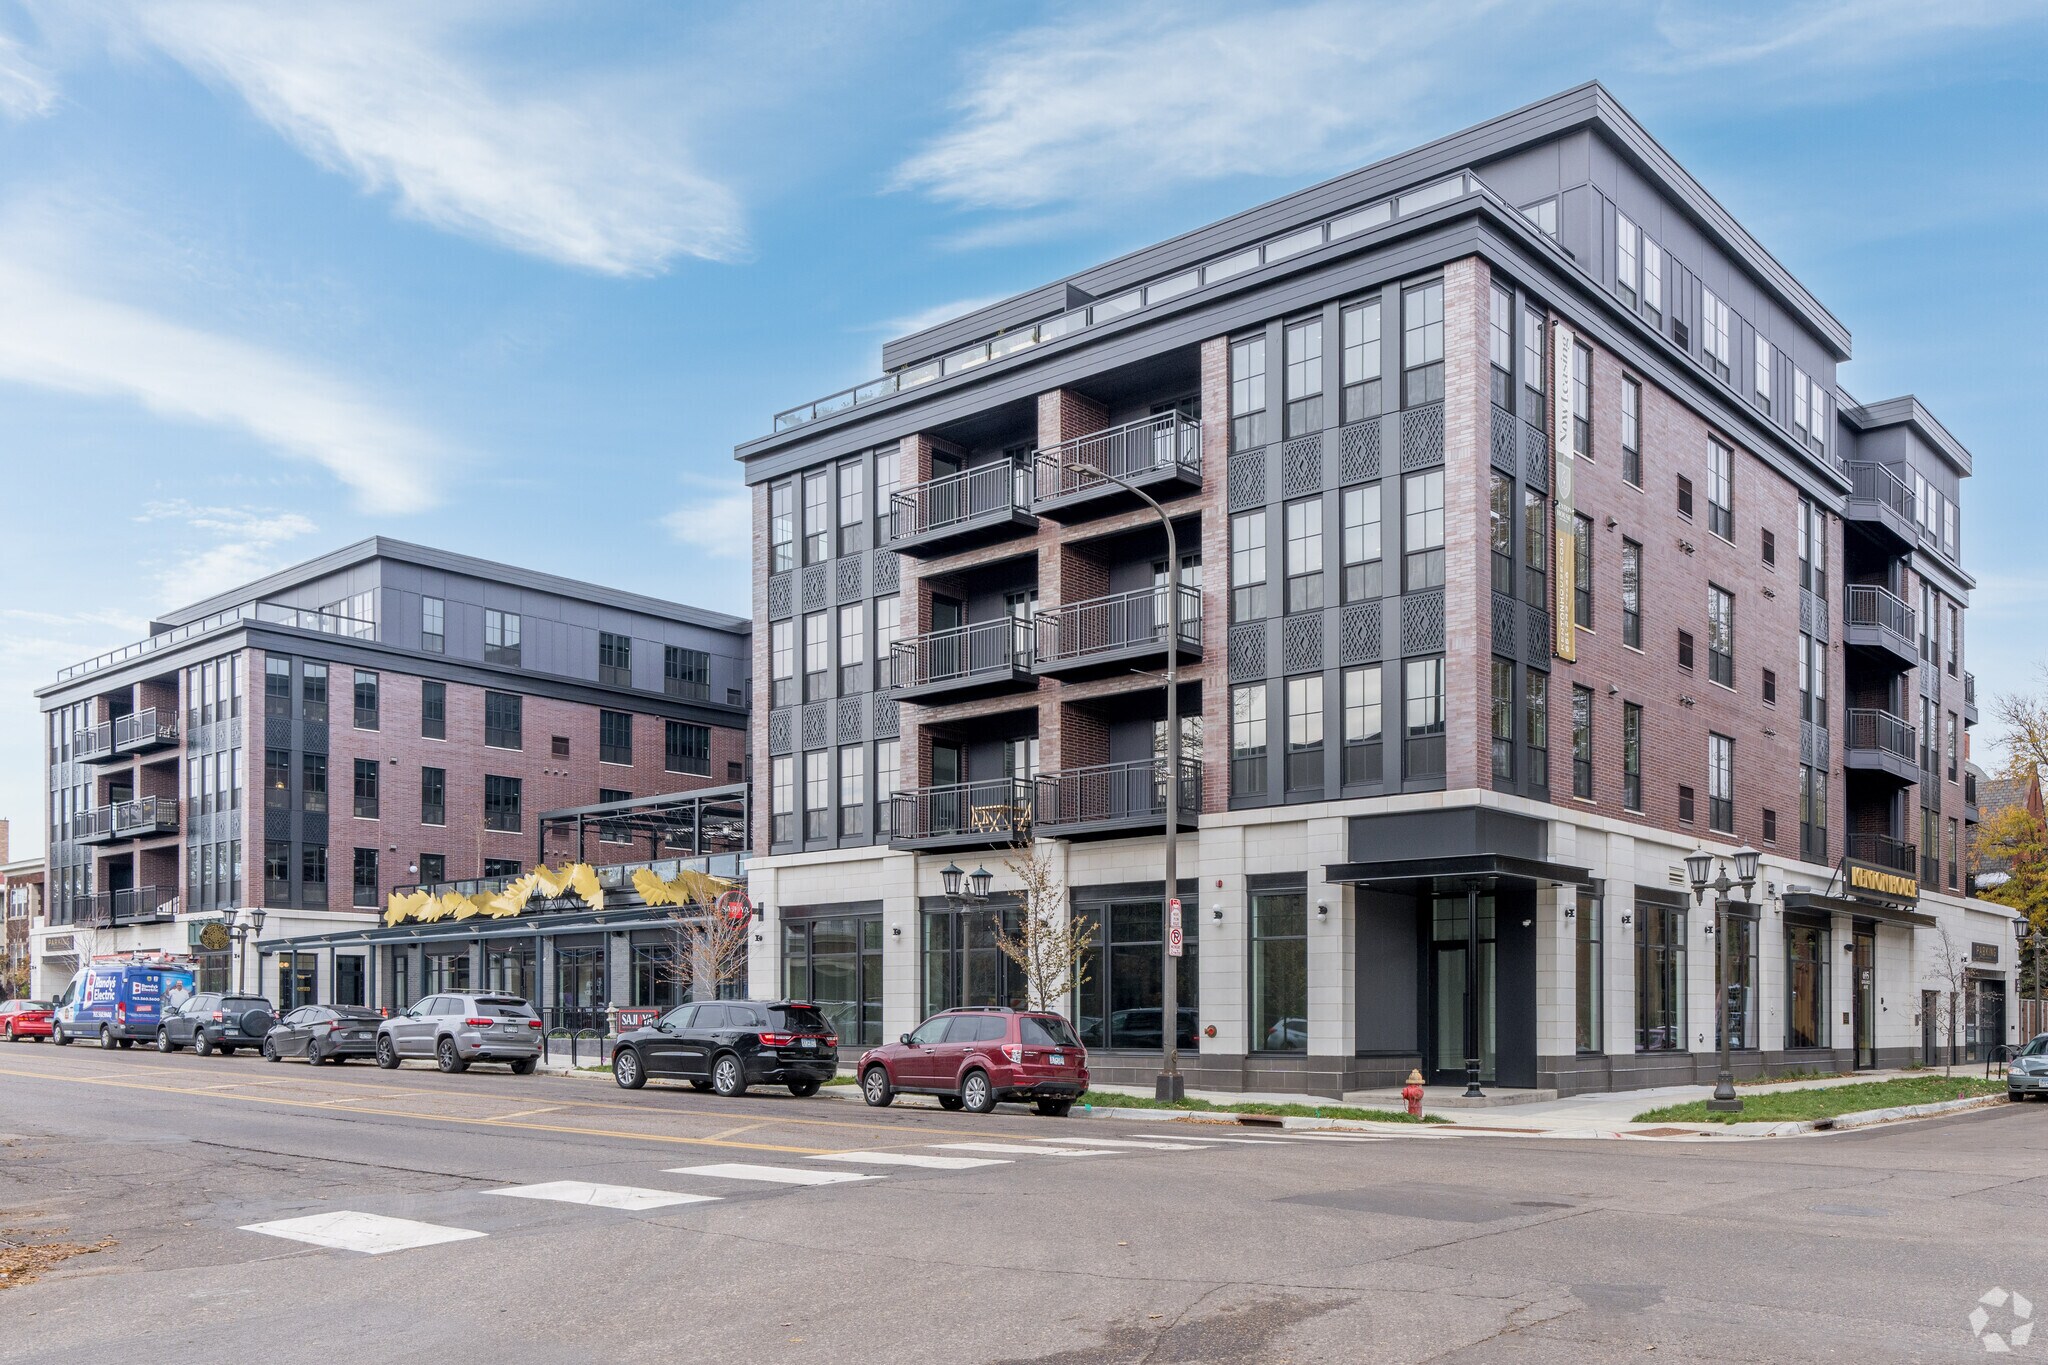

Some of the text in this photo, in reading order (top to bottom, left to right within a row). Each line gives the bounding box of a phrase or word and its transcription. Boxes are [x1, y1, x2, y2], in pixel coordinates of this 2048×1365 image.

[1559, 404, 1569, 446] Now
[95, 976, 116, 991] Randy's
[94, 990, 115, 1001] Electric
[621, 1013, 638, 1025] SAJI
